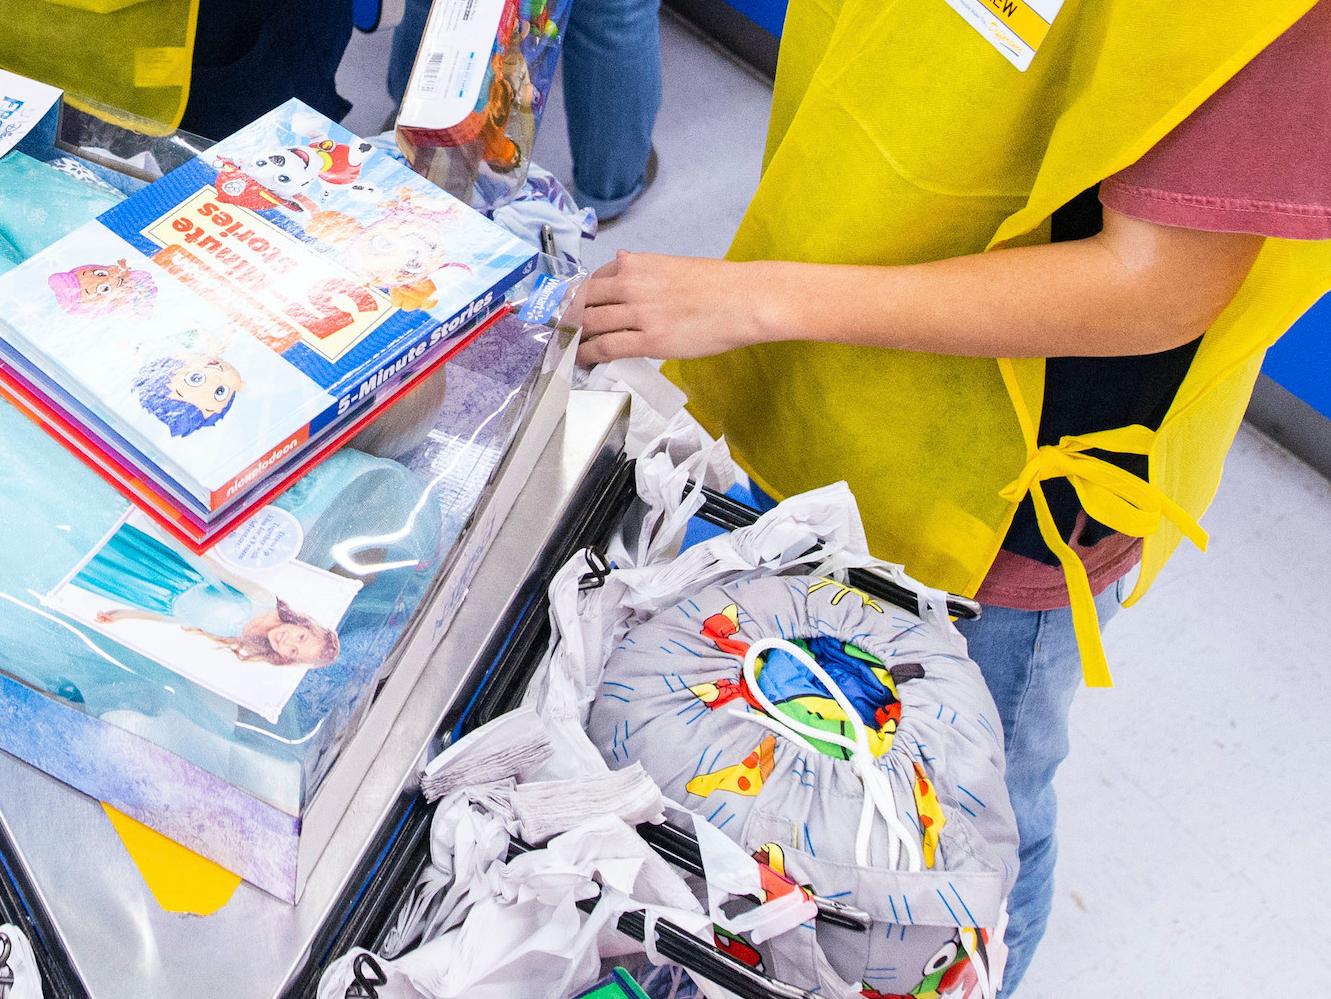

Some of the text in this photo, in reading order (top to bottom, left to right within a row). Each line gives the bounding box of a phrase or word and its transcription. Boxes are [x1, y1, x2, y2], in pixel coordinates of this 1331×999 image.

[534, 278, 560, 311] Walmart
[337, 338, 429, 416] 5-Minute
[428, 290, 495, 347] Stories
[225, 437, 299, 498] nickelodeon
